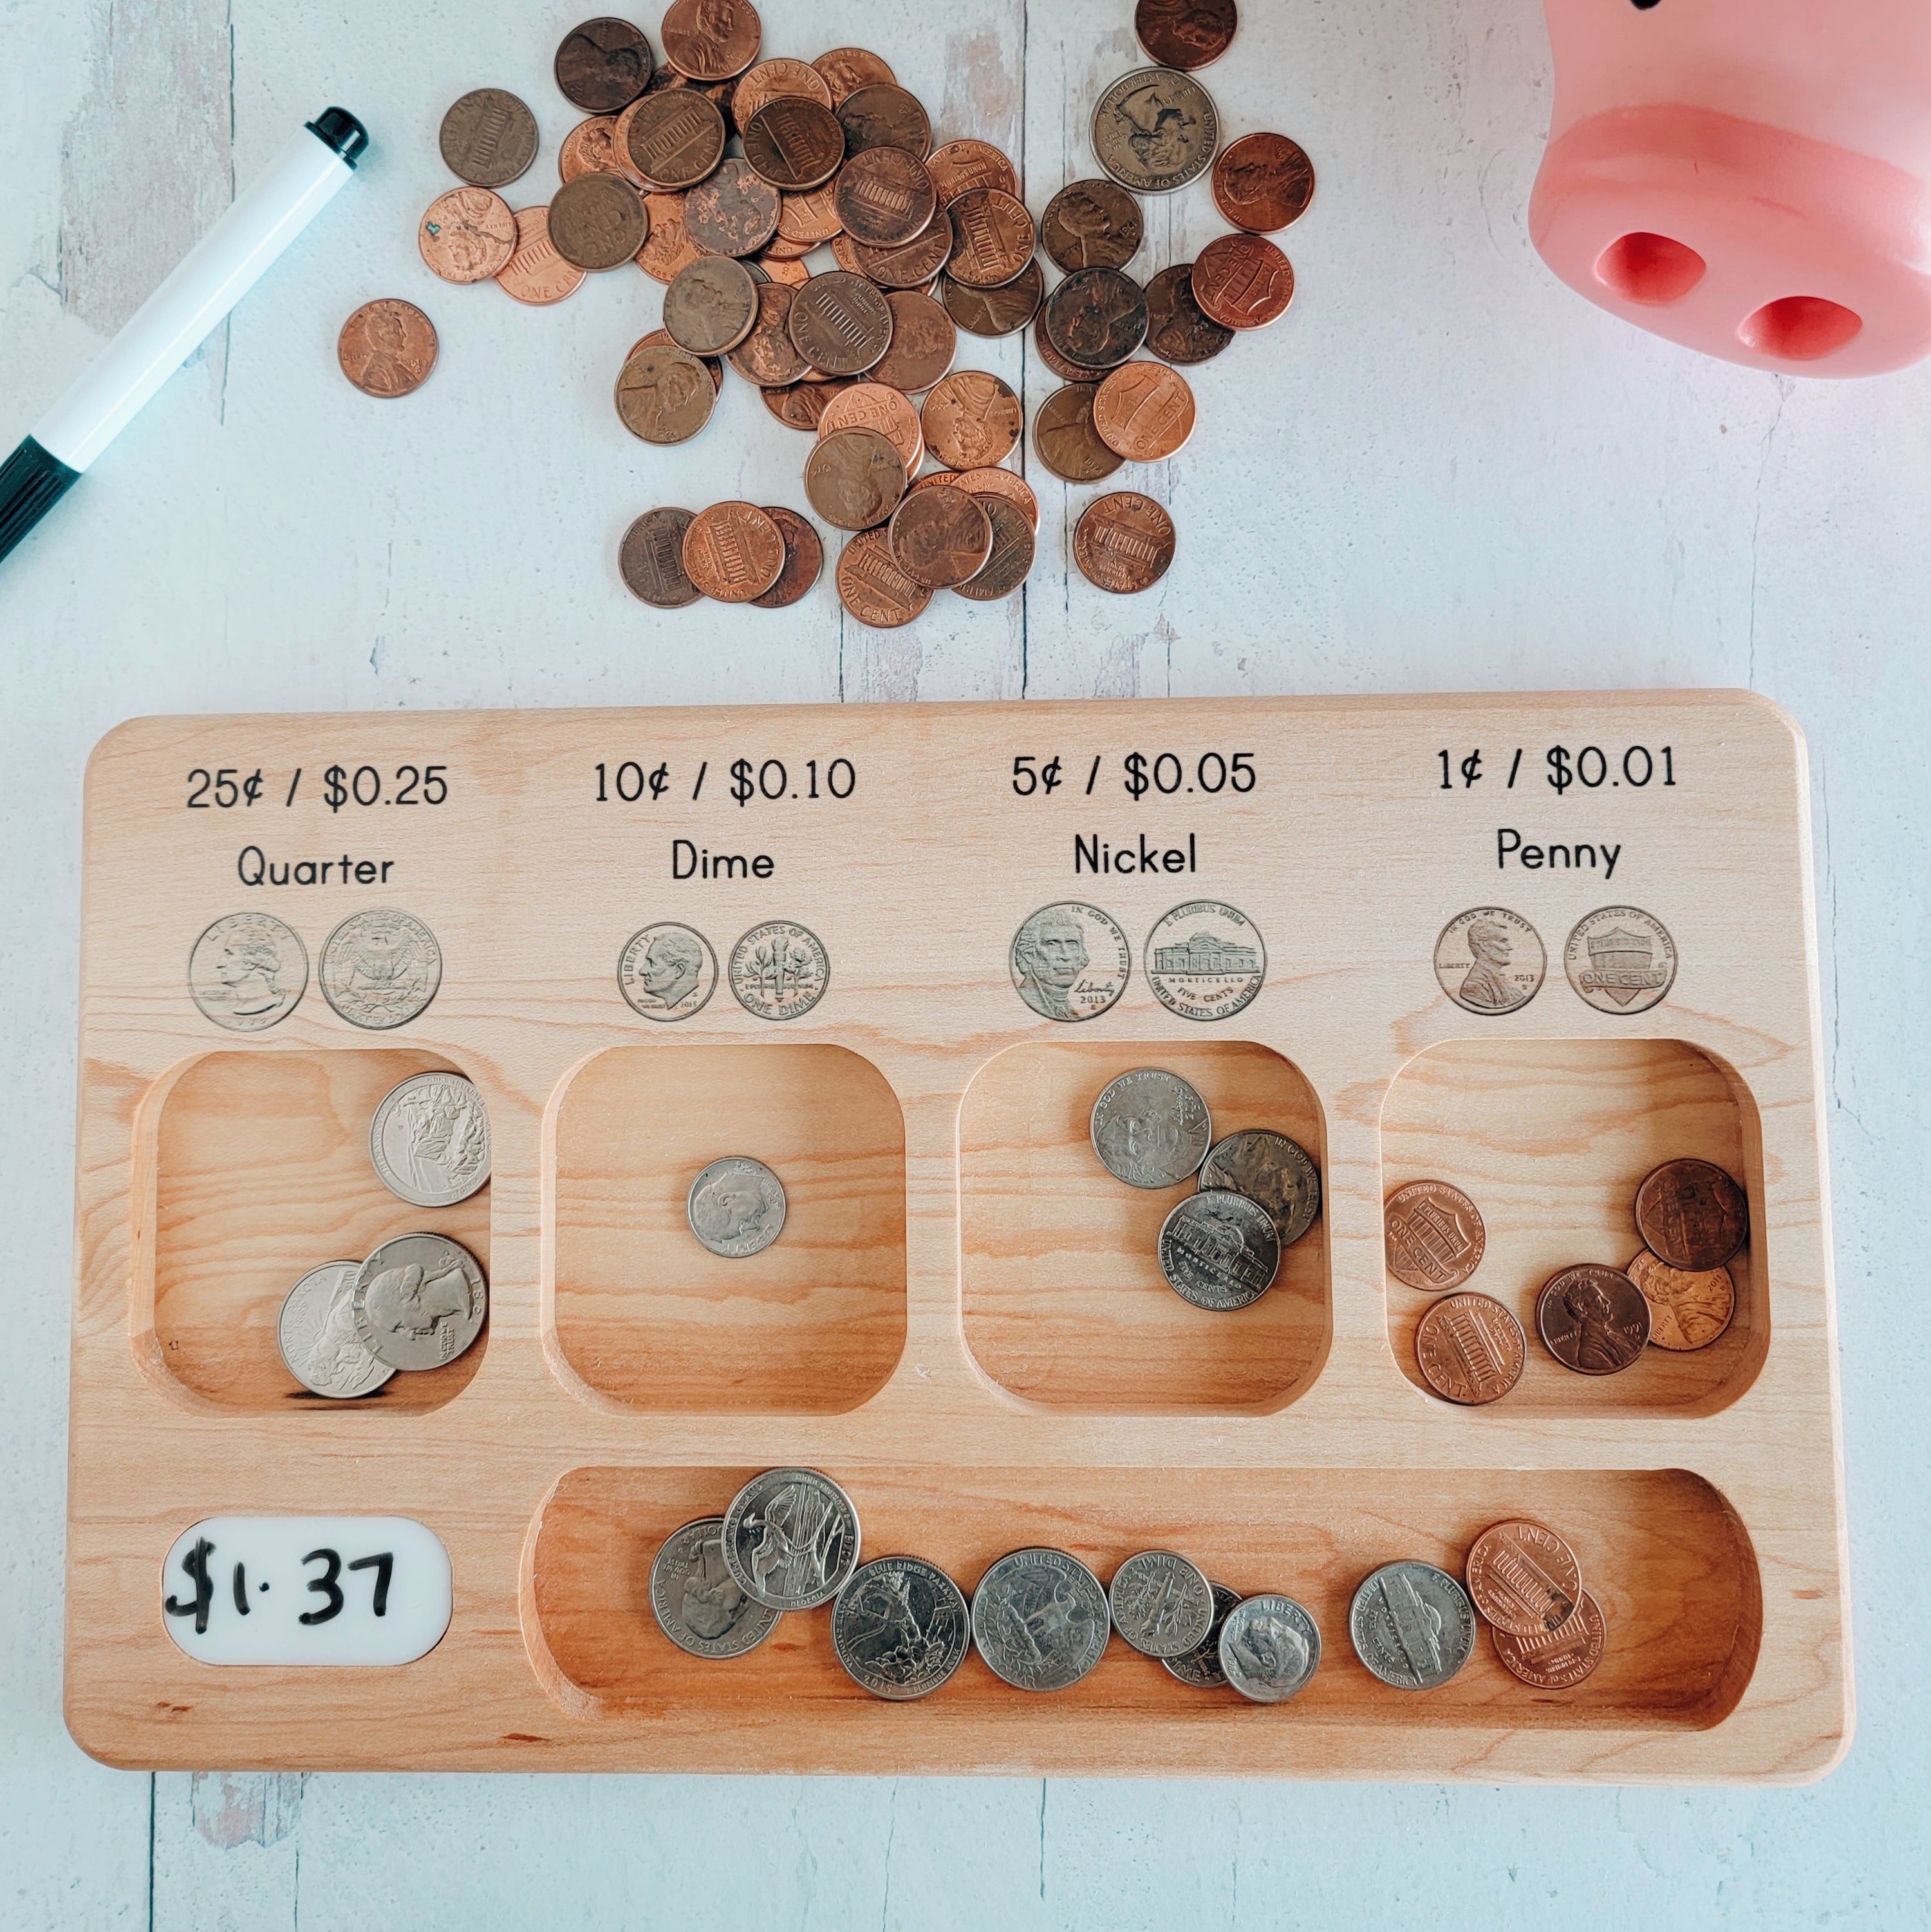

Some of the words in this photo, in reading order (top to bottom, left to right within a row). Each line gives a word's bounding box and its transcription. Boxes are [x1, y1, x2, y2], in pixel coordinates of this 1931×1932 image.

[747, 63, 789, 89] CENT
[794, 70, 821, 91] ONE
[745, 121, 764, 148] ONE
[1202, 111, 1217, 155] UNITED
[1108, 155, 1153, 188] AMERICA
[1159, 178, 1173, 187] OF
[1174, 154, 1207, 186] STATES
[792, 227, 830, 240] UNITED
[1231, 242, 1253, 269] ONE
[520, 285, 550, 299] ONE
[794, 312, 809, 344] ONE
[809, 346, 849, 370] CENT
[825, 409, 867, 438] CENT
[870, 400, 898, 418] ONE
[1134, 423, 1159, 452] ONE
[1157, 390, 1188, 426] CENT
[1101, 495, 1144, 515] CENT
[1143, 502, 1173, 537] ONE
[847, 529, 881, 556] UNITED
[840, 577, 862, 606] ONE
[860, 606, 902, 624] CENT
[595, 762, 669, 802] 10¢
[692, 762, 707, 801] /
[730, 758, 855, 805] $0.10
[1012, 756, 1062, 796] 5¢
[1085, 755, 1101, 795] /
[1124, 751, 1256, 802] $0.05
[1437, 749, 1483, 789] 1¢
[1507, 748, 1523, 789] /
[1546, 745, 1676, 796] $0.01
[187, 768, 263, 808] 25¢
[286, 767, 302, 807] /
[324, 764, 447, 814] $0.25
[238, 845, 395, 886] Quarter
[673, 839, 774, 879] Dime
[1075, 832, 1195, 874] Nickel
[1497, 828, 1621, 880] Penny
[1173, 904, 1216, 924] PLURIBUS
[1448, 922, 1459, 933] IN
[1458, 912, 1477, 926] GOD
[1502, 911, 1533, 933] TRUST
[1070, 905, 1083, 914] IN
[1087, 909, 1109, 927] GOD
[1109, 926, 1123, 943] WE
[1116, 944, 1128, 980] TRUST
[1568, 924, 1589, 961] UNITED
[1589, 909, 1627, 927] STATES
[1628, 910, 1644, 921] OF
[1643, 917, 1674, 961] AMERICA
[624, 933, 651, 986] LIBERTY
[734, 945, 748, 986] UNITED
[747, 926, 786, 946] STATES
[788, 928, 804, 939] OF
[801, 937, 825, 982] AMERICA
[1074, 979, 1115, 997] Liberty
[1176, 986, 1197, 1002] FIVE
[1203, 987, 1234, 1003] CENTS
[1582, 970, 1618, 986] ONE
[1618, 970, 1665, 986] CENT
[742, 993, 774, 1015] ONE
[778, 991, 819, 1017] DIME
[1080, 995, 1106, 1004] 2013
[1151, 975, 1177, 1007] UNITED
[1177, 1002, 1214, 1018] STATES
[1215, 1004, 1232, 1017] OF
[1231, 974, 1263, 1013] AMERICA
[1094, 1110, 1104, 1127] IN
[1100, 1089, 1117, 1110] GOD
[1116, 1076, 1134, 1092] WE
[1134, 1071, 1171, 1084] TRUST
[1274, 1136, 1287, 1148] IN
[1287, 1143, 1309, 1167] GOD
[1304, 1167, 1318, 1185] WE
[1205, 1194, 1213, 1205] E
[1215, 1194, 1260, 1218] PLURIBUS
[1255, 1215, 1278, 1243] UNUM
[1302, 1185, 1318, 1223] TRUST
[1397, 1183, 1438, 1205] UNITED
[1438, 1185, 1475, 1214] STATES
[1469, 1213, 1484, 1228] OF
[1418, 1203, 1426, 1212] E
[1424, 1206, 1453, 1237] PLURIBUS
[1447, 1231, 1464, 1253] UNUM
[1391, 1219, 1417, 1248] ONE
[1412, 1244, 1448, 1284] CENT
[1161, 1237, 1175, 1274] UNITED
[1169, 1272, 1200, 1304] STATES
[1199, 1295, 1218, 1309] OF
[1215, 1289, 1260, 1309] AMERICA
[1177, 1260, 1195, 1281] FIVE
[1195, 1279, 1228, 1295] CENTS
[1567, 1271, 1581, 1282] WE
[1707, 1273, 1723, 1293] 2011
[355, 1250, 384, 1354] LIBERTY
[1450, 1297, 1492, 1311] UNITED
[1490, 1304, 1520, 1339] STATES
[1650, 1313, 1674, 1341] LIBERTY
[447, 1327, 456, 1356] TRUST
[1419, 1322, 1441, 1360] ONE
[1426, 1361, 1468, 1400] CENT
[1491, 1350, 1524, 1396] AMERICA
[1517, 1523, 1560, 1555] CENT
[1014, 1552, 1063, 1569] UNITED
[1139, 1553, 1178, 1571] DIME
[1179, 1565, 1206, 1598] ONE
[165, 1536, 394, 1635] $1.37
[868, 1560, 894, 1578] BLUE
[895, 1560, 928, 1578] RIDGE
[930, 1571, 964, 1613] PARKWAY
[1356, 1579, 1381, 1614] UNITED
[655, 1579, 682, 1634] AMERICA
[1260, 1599, 1314, 1637] LIBERTY
[680, 1631, 696, 1646] OF
[1124, 1627, 1139, 1642] OF
[1182, 1608, 1209, 1648] UNITED
[1354, 1614, 1370, 1653] STATES
[1587, 1612, 1603, 1657] UNITED
[698, 1641, 740, 1654] STATES
[1140, 1638, 1182, 1655] STATES
[1370, 1635, 1396, 1665] CENTS
[1505, 1646, 1547, 1684] AMERICA
[1562, 1655, 1596, 1685] STATES
[863, 1673, 893, 1694] 2015
